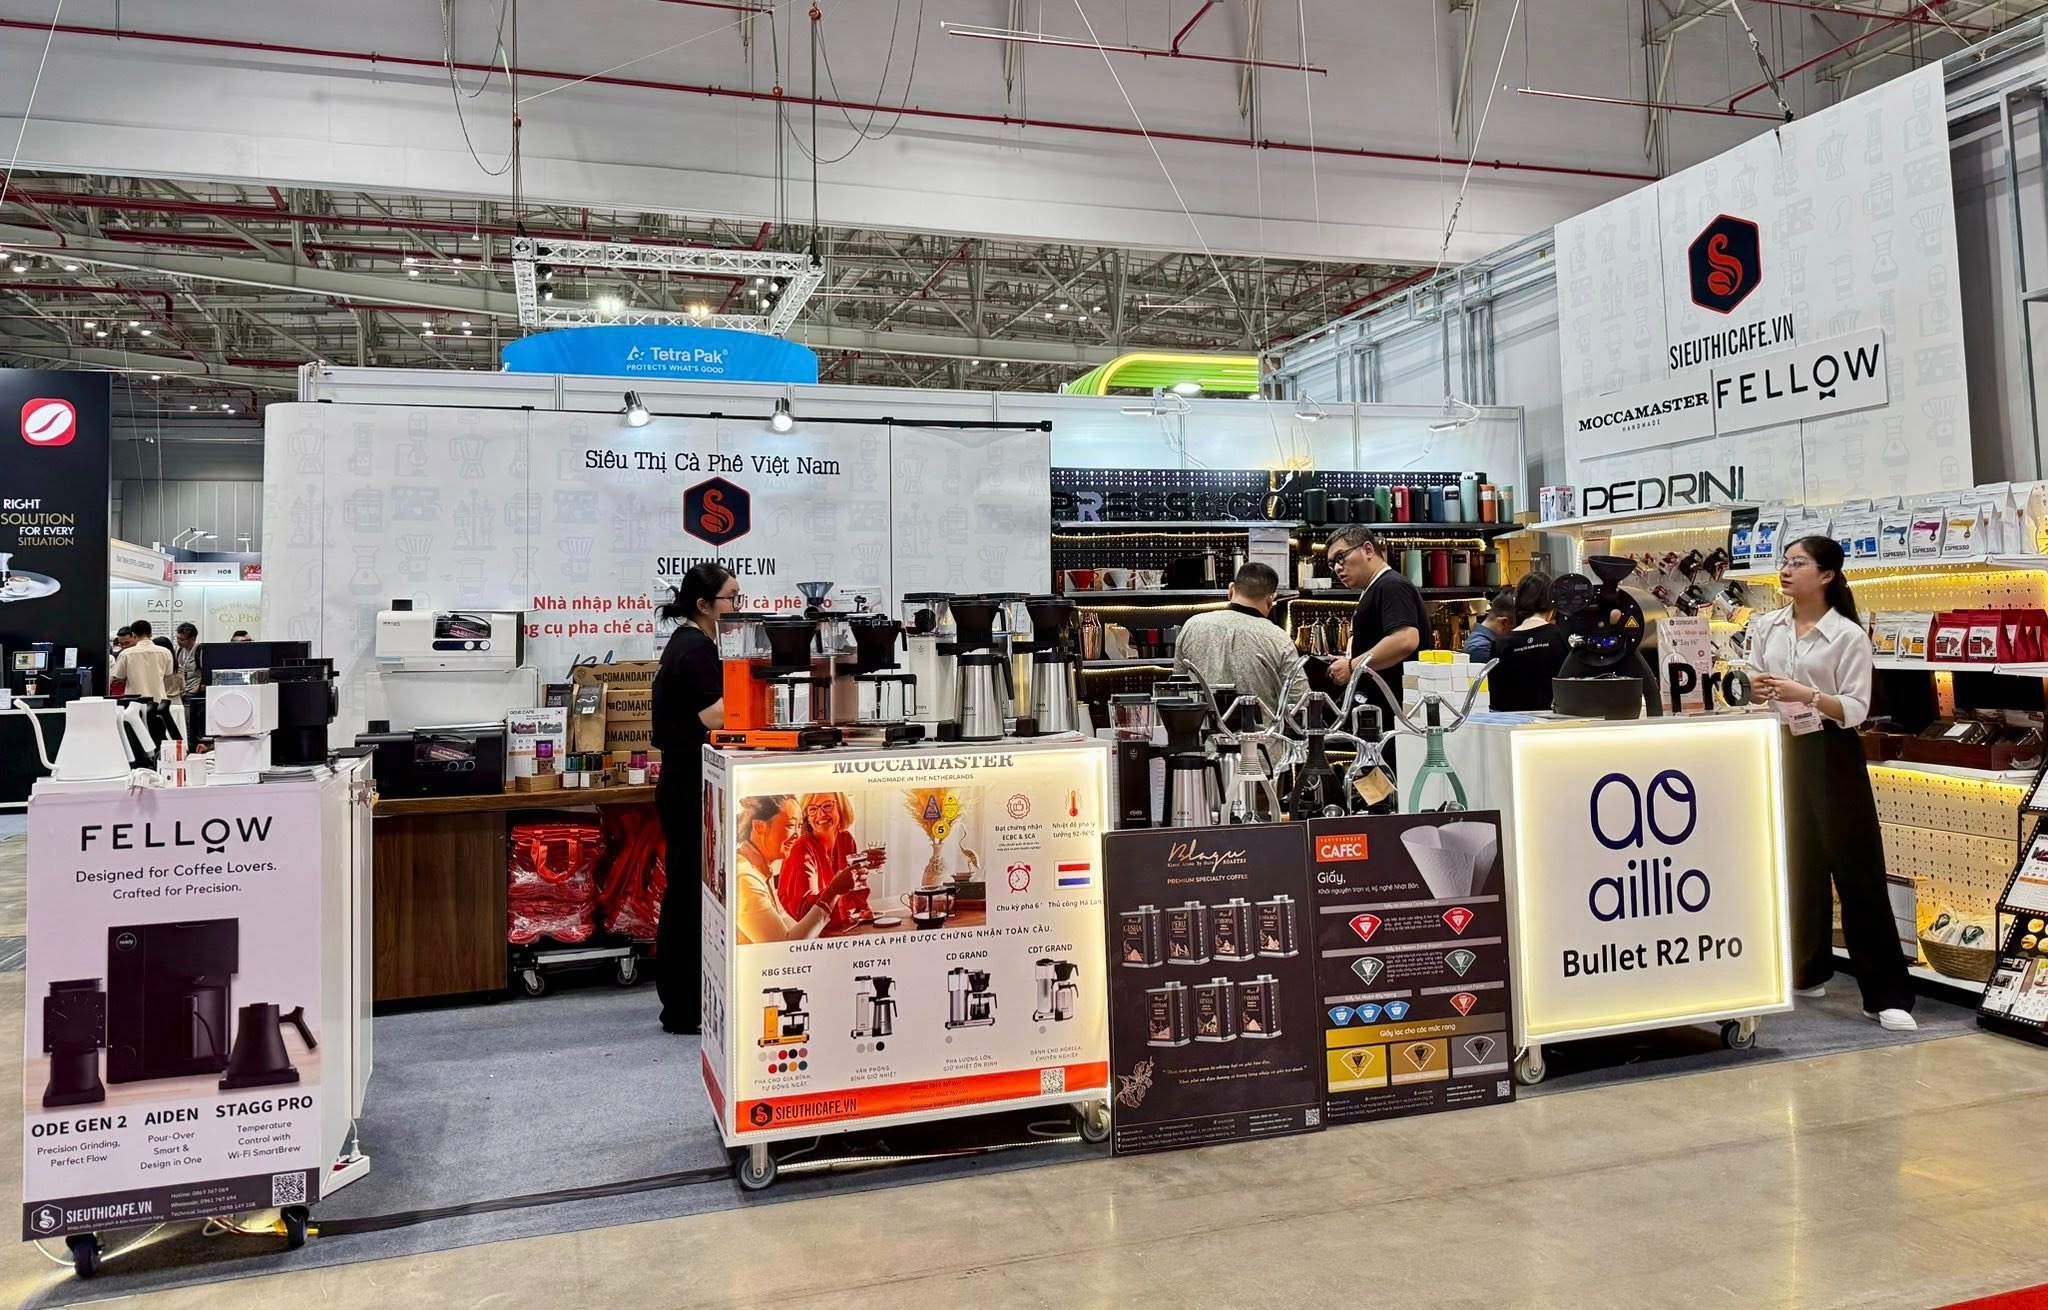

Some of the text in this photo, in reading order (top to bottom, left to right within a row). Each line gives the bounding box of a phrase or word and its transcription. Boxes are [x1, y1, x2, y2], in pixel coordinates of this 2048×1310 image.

[1669, 313, 1794, 370] SIEUTHICAFE.VN
[651, 347, 690, 362] Tetra
[669, 365, 699, 373] WHAT'S
[701, 366, 724, 374] GOOD
[1717, 344, 1879, 409] FELLOW
[1579, 392, 1709, 432] MOCCAMASTER
[1622, 419, 1661, 433] HANDMADE
[586, 450, 841, 477] Siêu Thị Cà Phê Việt Nam
[1583, 466, 1743, 517] PEDRINI
[4, 499, 41, 510] RIGHT
[1, 513, 74, 525] SOLUTION
[20, 527, 75, 536] FOR EVERY
[18, 536, 74, 546] SITUATION
[534, 596, 567, 610] Nhà
[572, 596, 612, 612] nhập
[753, 596, 769, 609] cà
[775, 596, 802, 612] phê
[544, 624, 563, 638] cụ
[569, 620, 598, 638] pha
[604, 618, 632, 634] chế
[636, 620, 654, 634] cà
[1668, 663, 1752, 713] Pro
[832, 754, 1014, 775] MOCCAMASTER
[928, 773, 974, 781] NETHERLANDS
[80, 816, 273, 854] FELLOW
[937, 826, 945, 834] 5
[1007, 824, 1026, 832] chứng
[1168, 839, 1246, 873] Blagu
[1321, 844, 1361, 858] CAFEC
[76, 860, 278, 884] Designed for Coffee Lovers.
[1317, 870, 1346, 885] Giấy,
[113, 883, 242, 900] Crafted for Precision.
[1331, 886, 1352, 896] nguyên
[1379, 884, 1393, 892] nghệ
[1589, 856, 1711, 922] aillio
[1011, 903, 1019, 912] kỳ
[1021, 903, 1034, 912] pha
[1048, 900, 1061, 908] Thủ
[789, 924, 1053, 954] CHUẨN MỰC PHA CÀ PHÊ ĐƯỢC CHỨNG NHẬN TOÀN CẦU.
[946, 950, 989, 961] CD GRAND
[1027, 943, 1073, 955] CDT GRAND
[1563, 935, 1743, 978] Bullet R2 Pro
[761, 965, 812, 977] KBG SELECT
[852, 958, 892, 969] KBGT 741
[1380, 1029, 1394, 1038] Giấy
[1395, 1028, 1404, 1037] lọc
[1417, 1025, 1428, 1034] các
[1428, 1025, 1441, 1033] mức
[868, 1065, 890, 1073] PHÒNG
[215, 1096, 314, 1119] STAGG PRO
[775, 1098, 857, 1121] SIEUTHICAFE.VN
[144, 1107, 199, 1126] AIDEN
[32, 1116, 128, 1138] ODE GEN 2
[237, 1121, 292, 1135] Temperature
[148, 1131, 195, 1143] Pour-Over
[238, 1132, 291, 1146] Control with
[37, 1140, 121, 1156] Precision Grinding,
[154, 1145, 190, 1156] Smart &
[228, 1145, 301, 1160] Wi-Fi SmartBrew
[51, 1153, 108, 1168] Perfect Flow
[140, 1156, 202, 1171] Design in One
[66, 1201, 152, 1224] SIEUTHICAFE.VN
